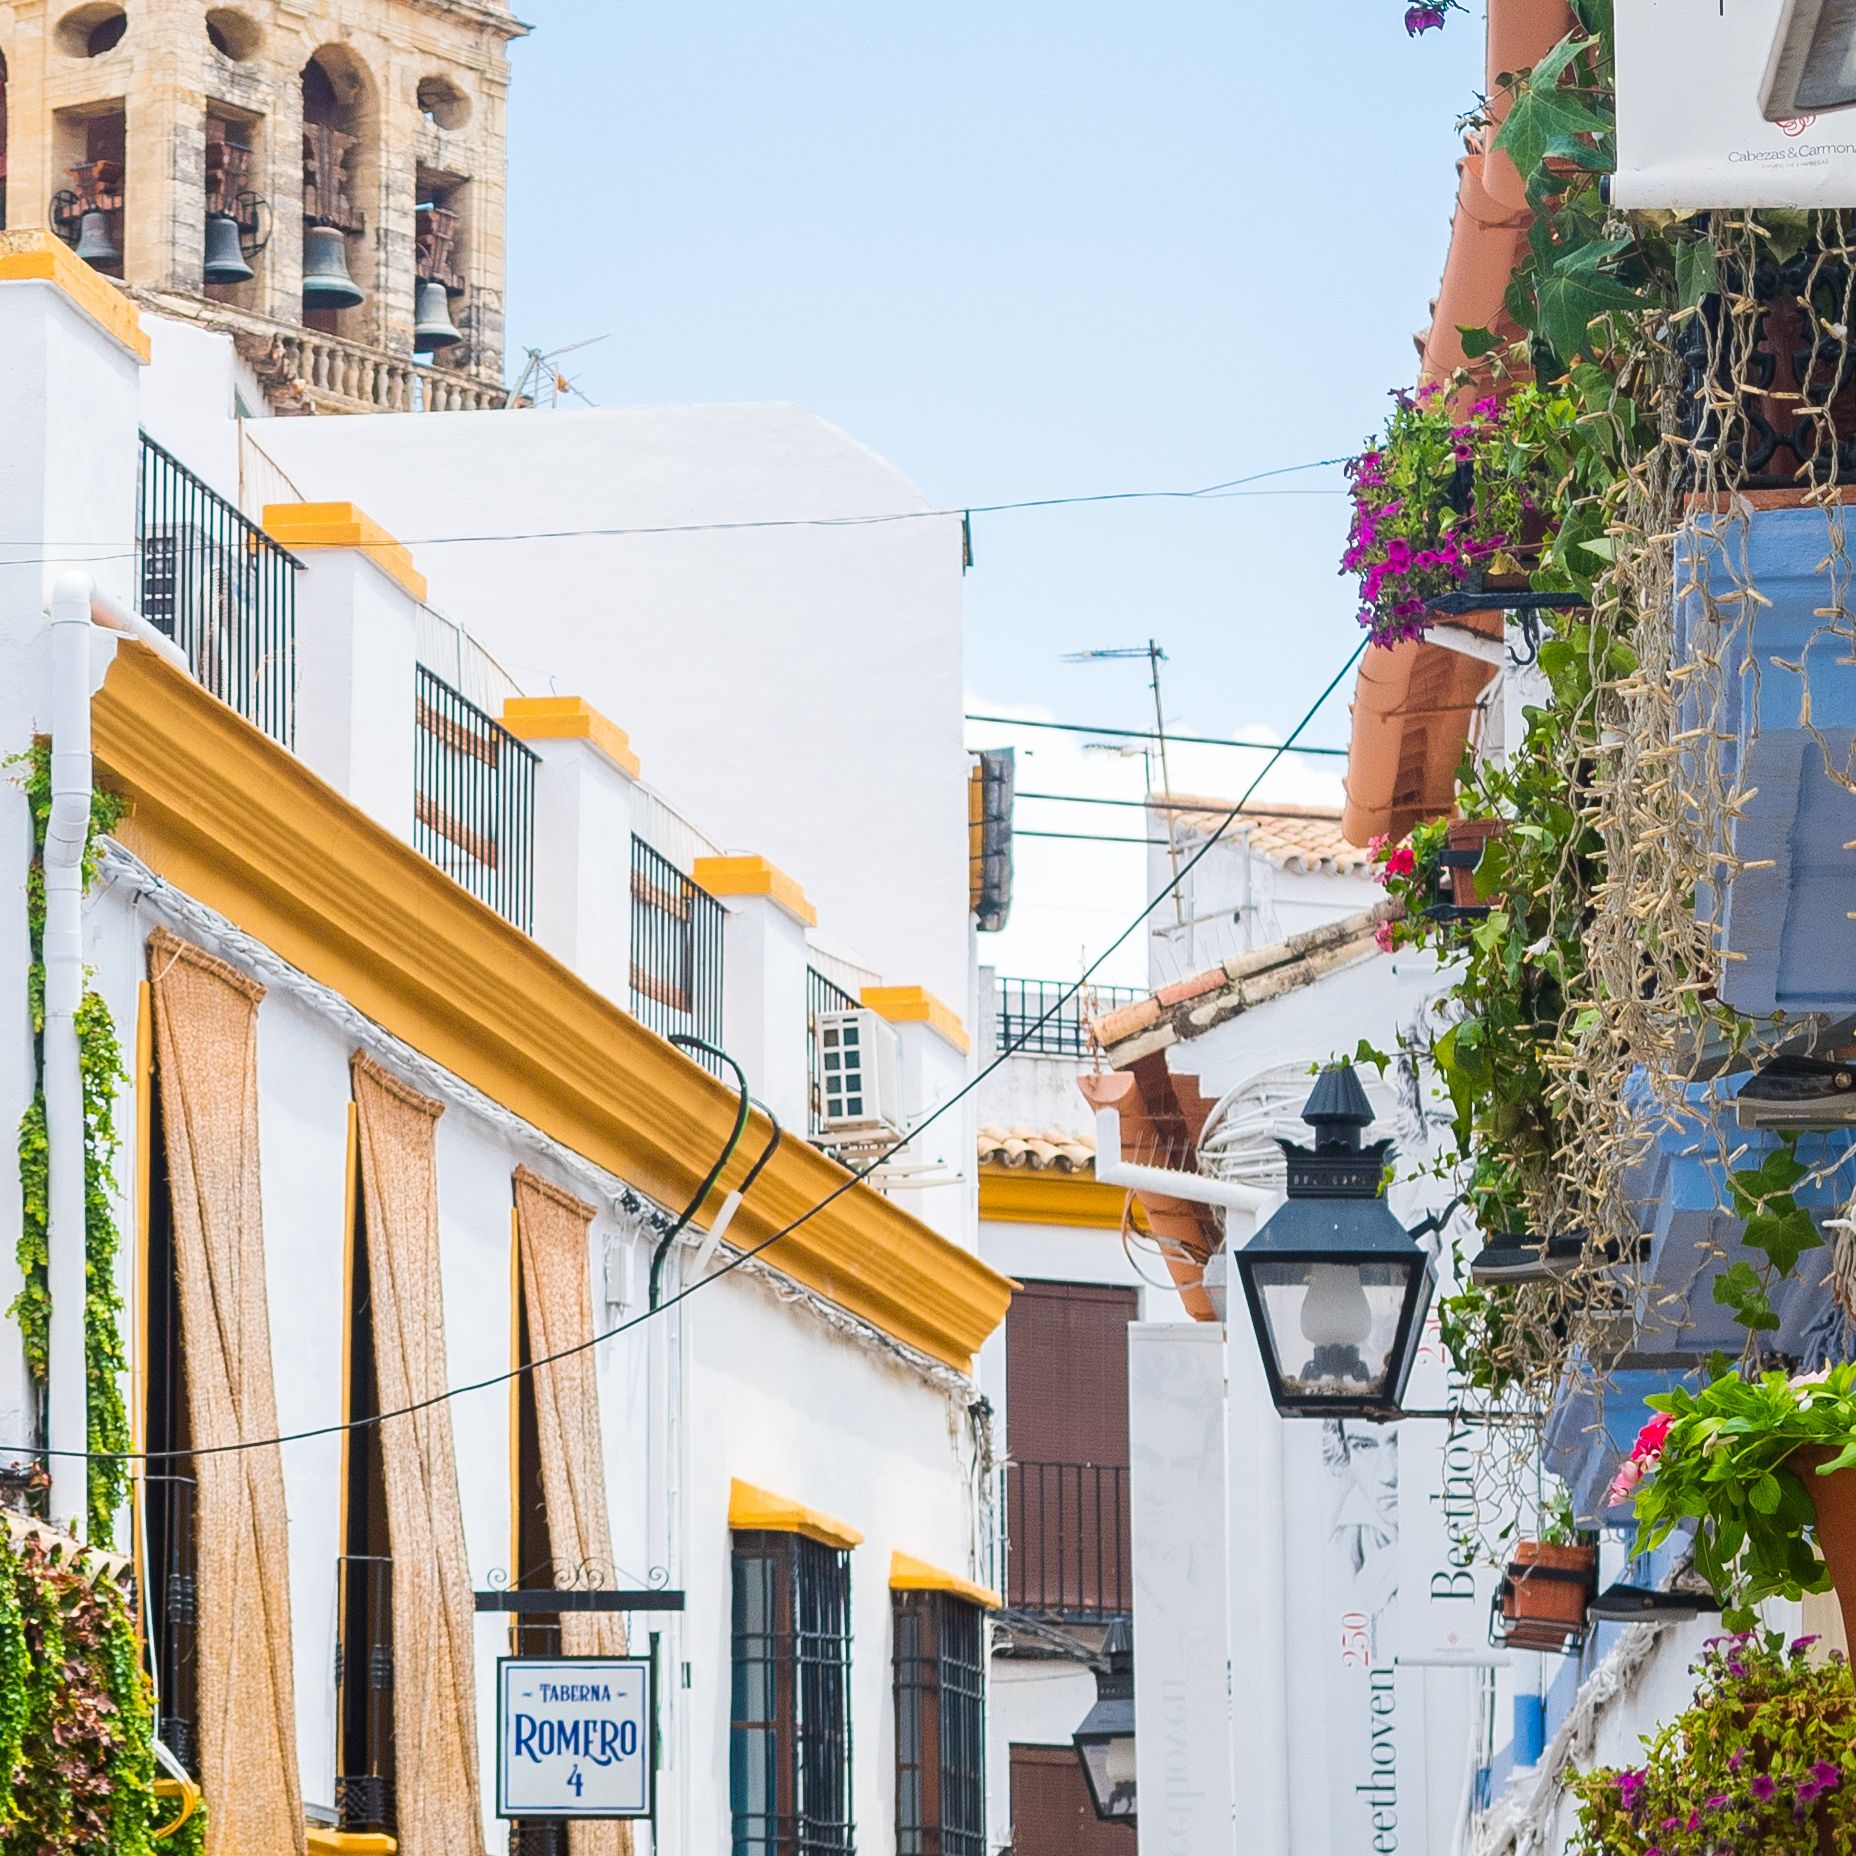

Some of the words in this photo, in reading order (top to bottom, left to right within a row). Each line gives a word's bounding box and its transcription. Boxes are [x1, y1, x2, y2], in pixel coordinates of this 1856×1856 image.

[1341, 1611, 1370, 1667] 250
[539, 1683, 611, 1703] TABERNA
[514, 1713, 637, 1766] ROMERO
[566, 1763, 584, 1797] 4
